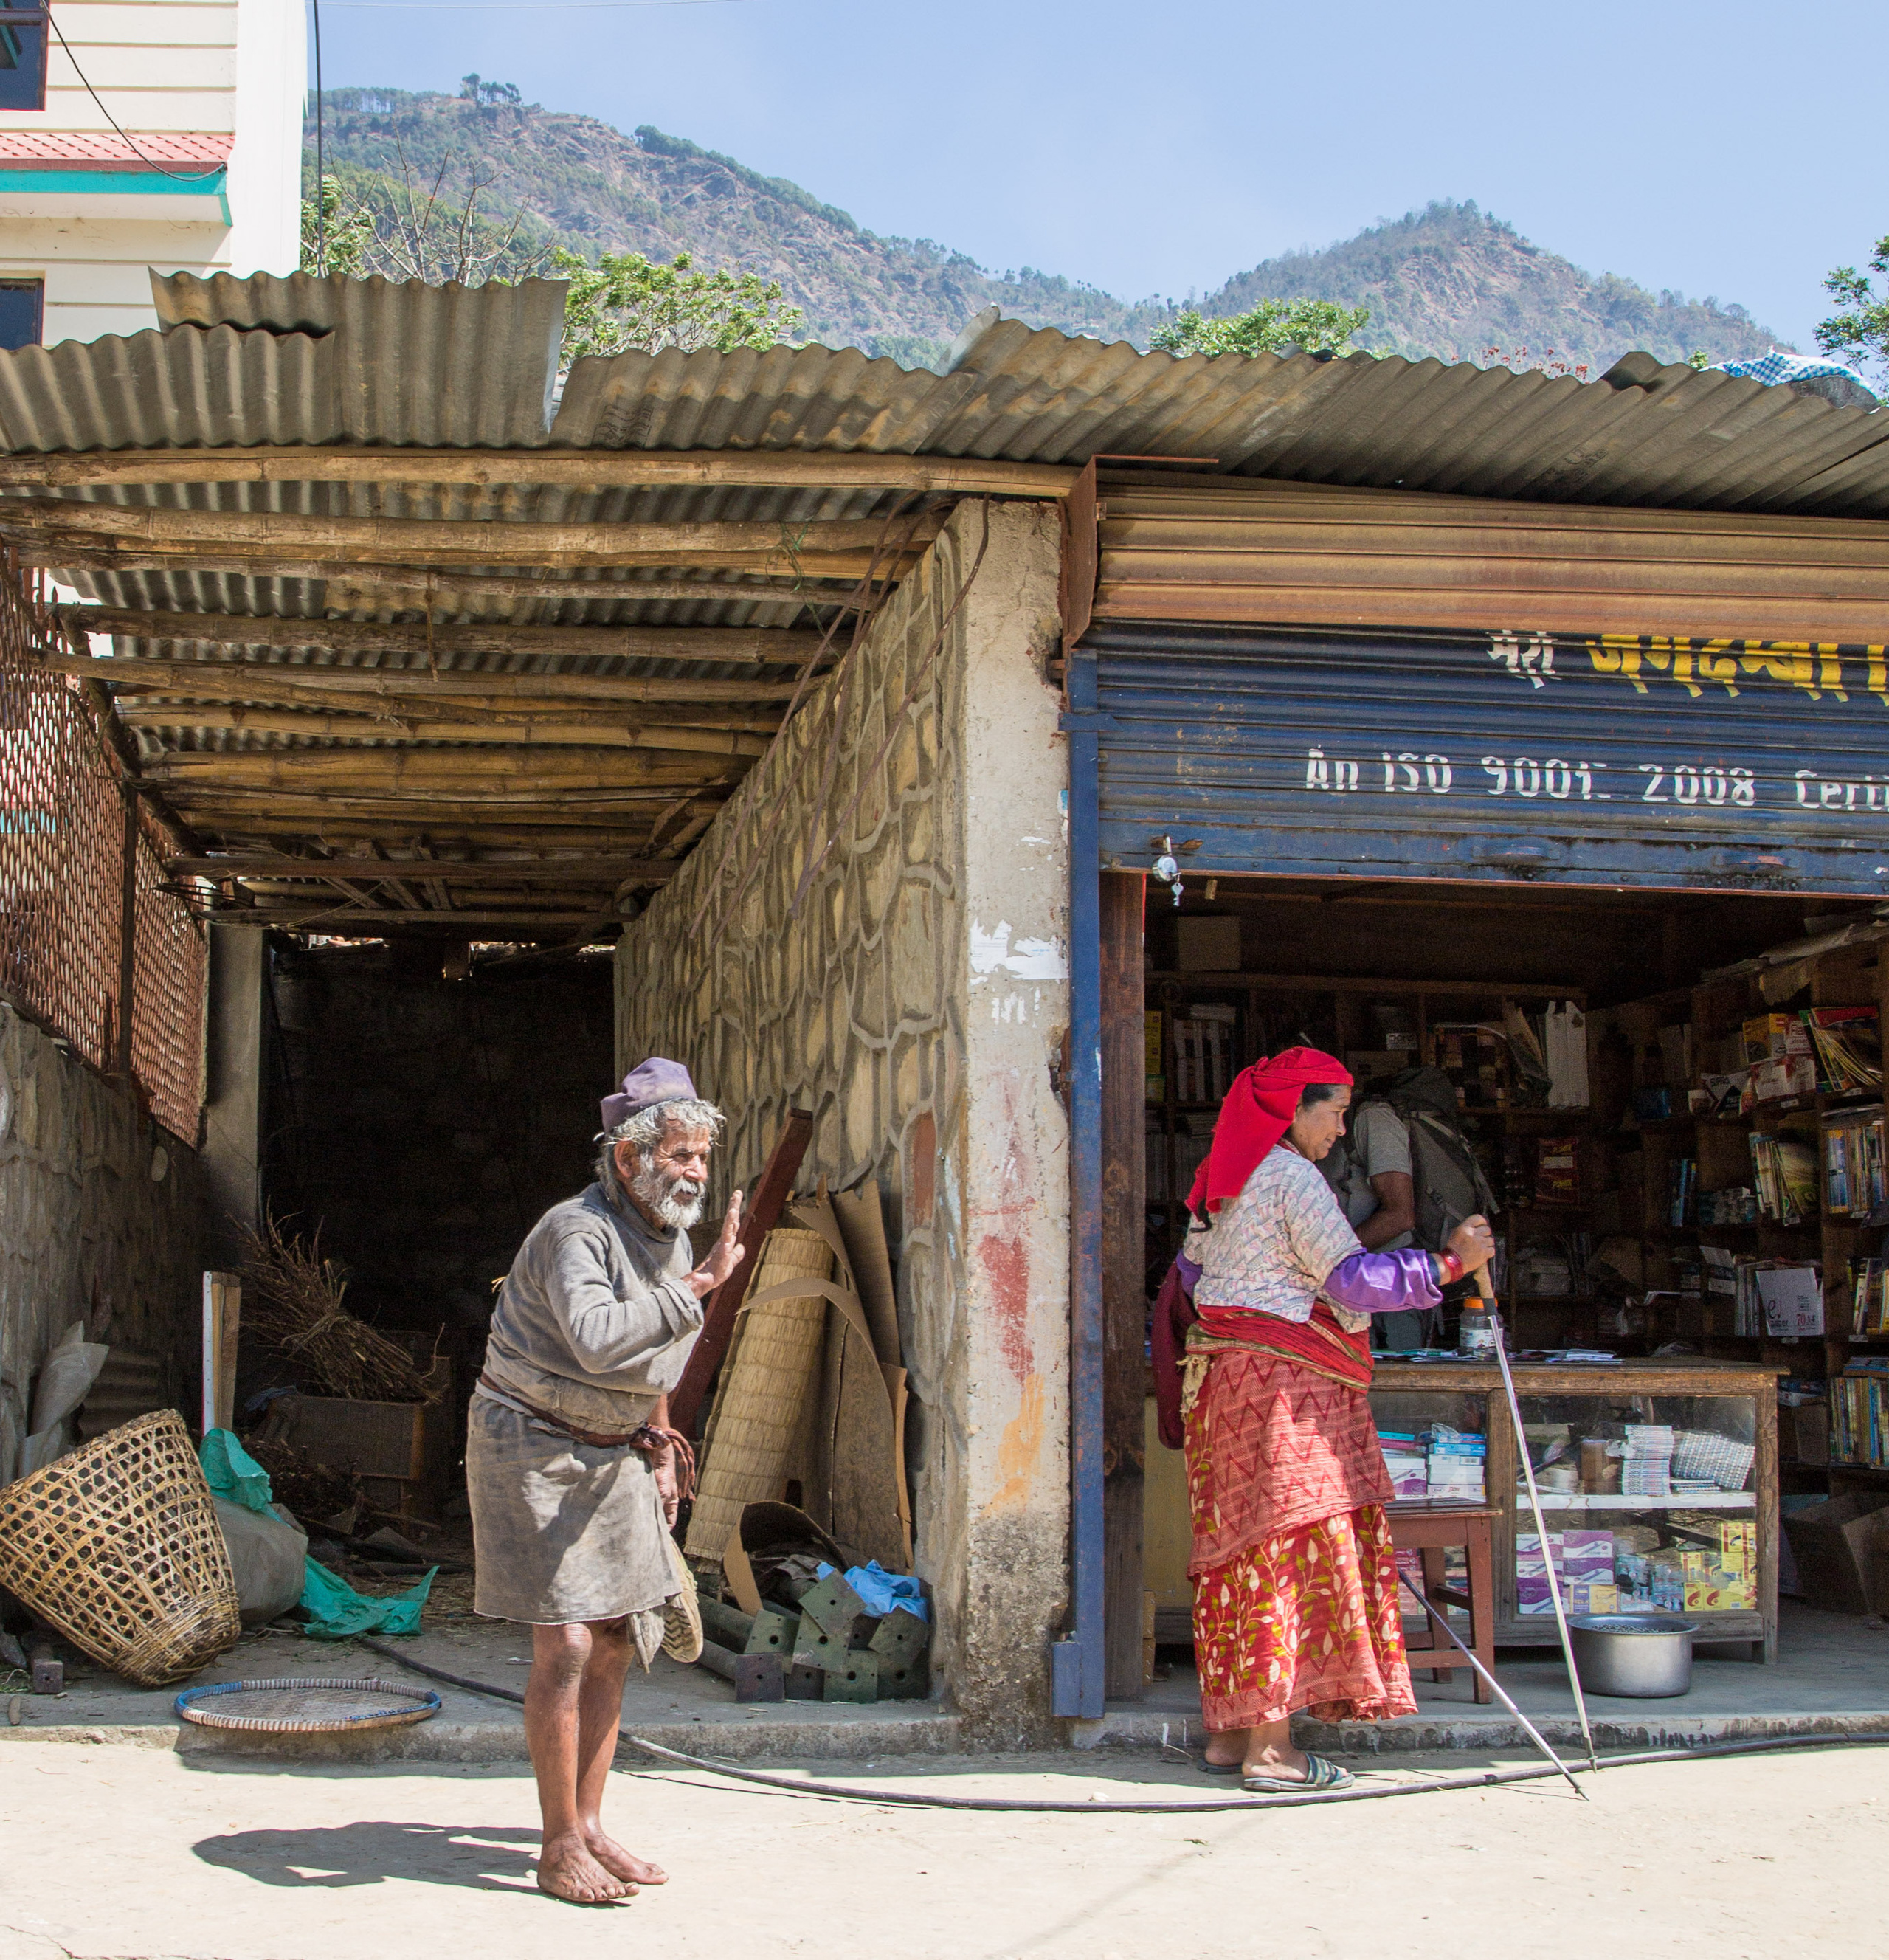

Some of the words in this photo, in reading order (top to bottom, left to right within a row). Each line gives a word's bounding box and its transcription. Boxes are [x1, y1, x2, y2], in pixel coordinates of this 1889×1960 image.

[1306, 748, 1358, 790] An
[1381, 751, 1451, 793] ISO
[1638, 763, 1755, 807] 2008
